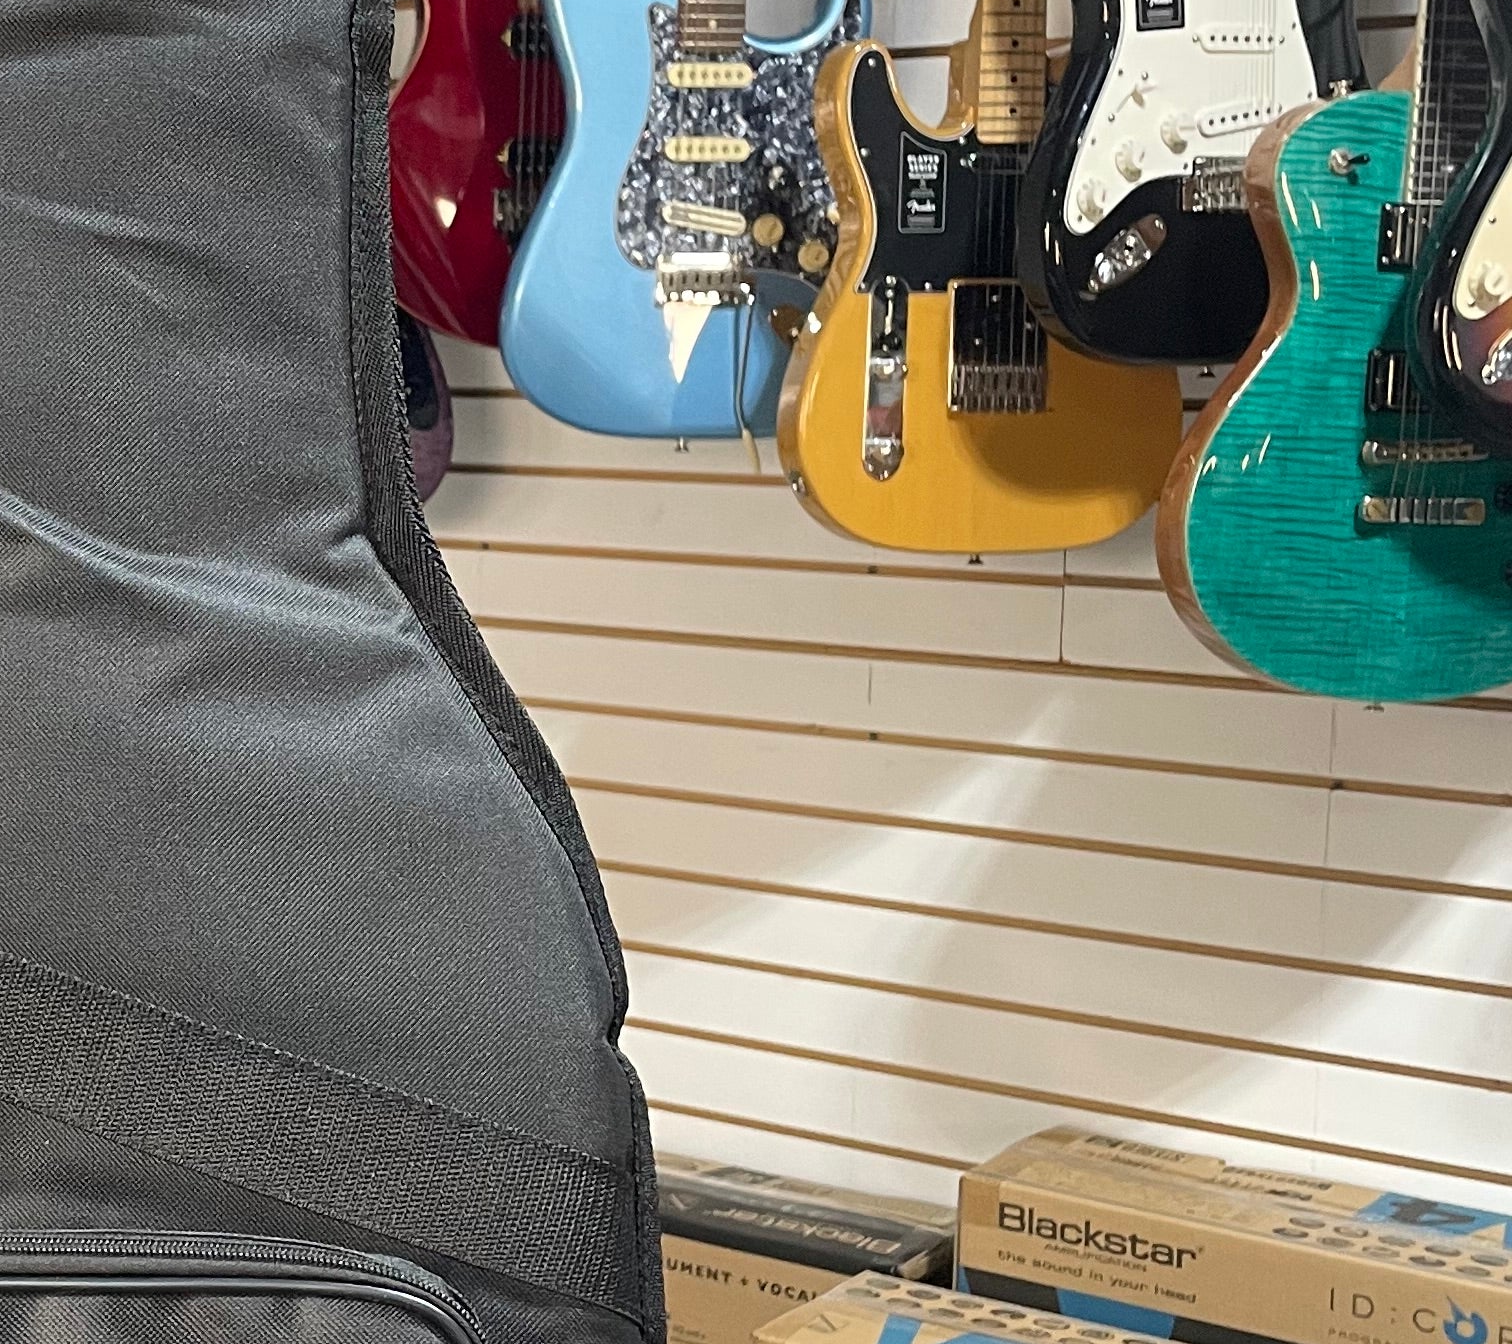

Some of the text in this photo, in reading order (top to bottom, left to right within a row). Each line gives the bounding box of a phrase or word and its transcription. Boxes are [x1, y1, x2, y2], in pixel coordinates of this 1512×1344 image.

[998, 1201, 1198, 1269] Blackstar
[998, 1249, 1027, 1265] the
[1032, 1259, 1083, 1278] sound
[1109, 1275, 1150, 1293] your
[1154, 1283, 1198, 1304] head
